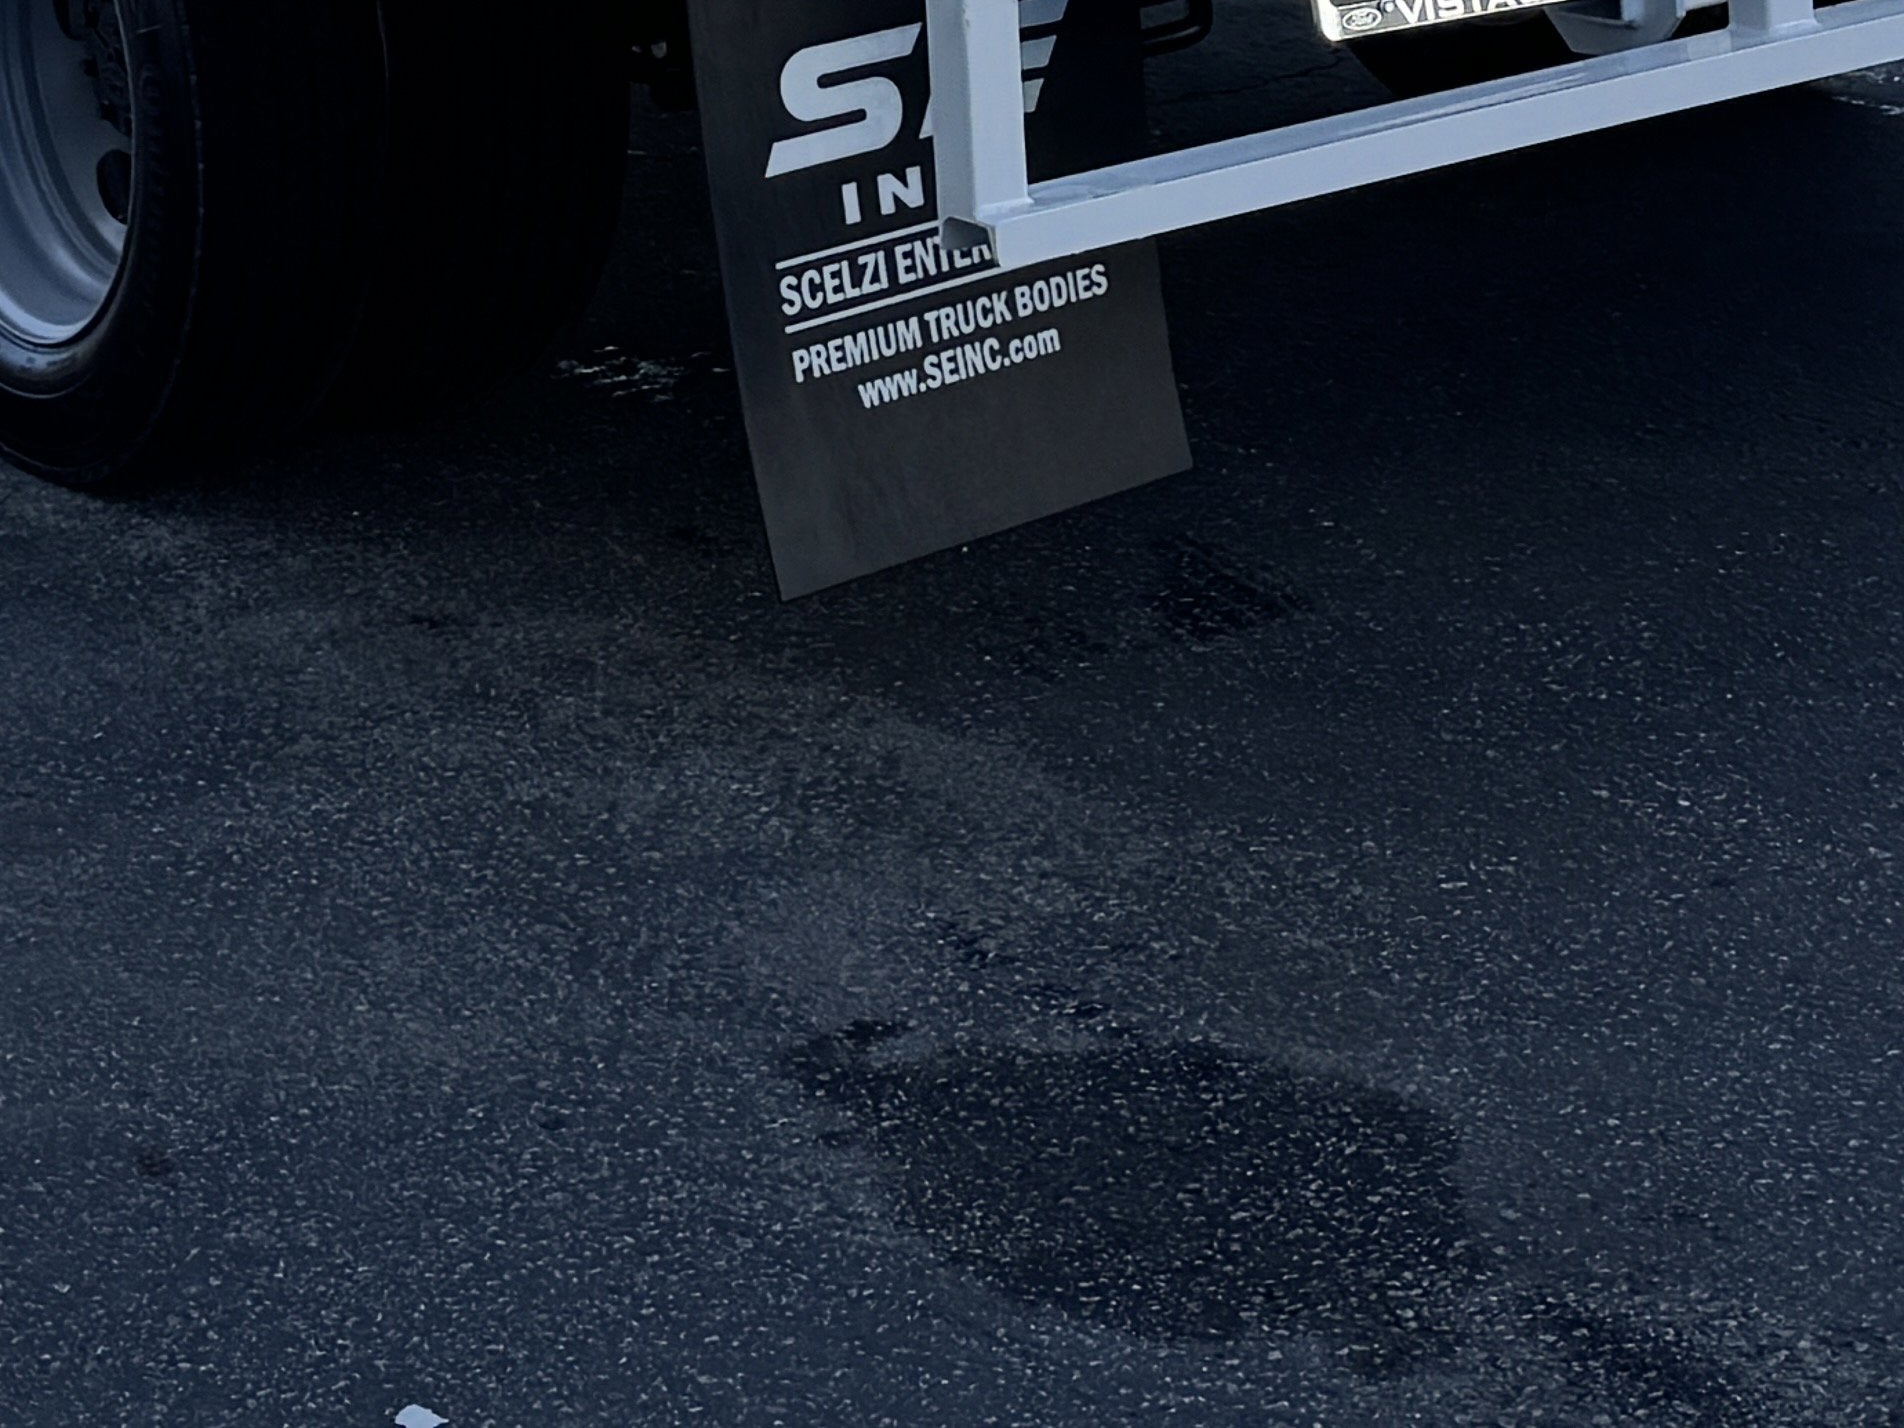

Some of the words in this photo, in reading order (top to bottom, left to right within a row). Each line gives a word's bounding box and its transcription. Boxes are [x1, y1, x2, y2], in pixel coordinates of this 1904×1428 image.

[841, 165, 926, 224] IN
[779, 250, 889, 316] SCELZI
[792, 316, 923, 384] PREMIUM
[924, 290, 1012, 344] TRUCK
[1014, 263, 1109, 318] BODIES
[858, 327, 1061, 409] www.SEINC.com
